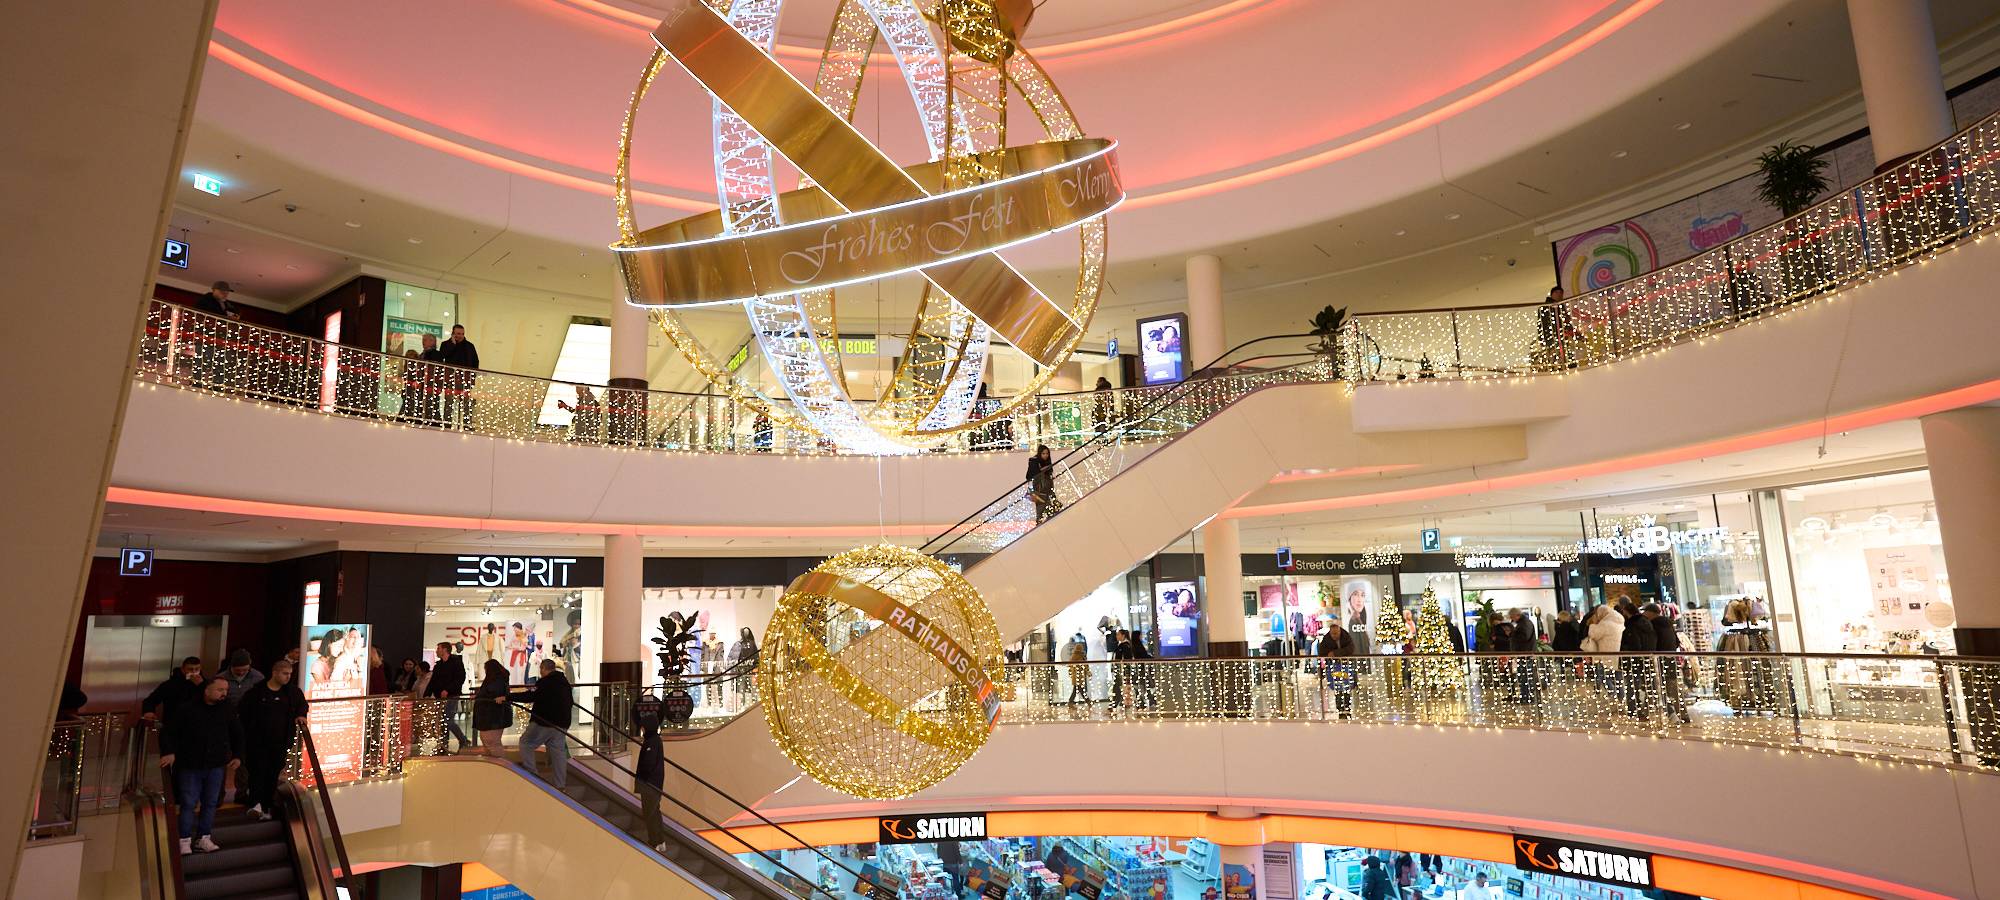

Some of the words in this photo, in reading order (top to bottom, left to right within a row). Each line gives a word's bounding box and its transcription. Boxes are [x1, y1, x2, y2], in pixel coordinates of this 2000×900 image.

[1059, 163, 1110, 208] Merry
[779, 219, 914, 284] Frohes
[926, 193, 1015, 254] Fest
[166, 241, 182, 258] P
[416, 325, 440, 335] NAILS
[846, 340, 877, 354] BODE
[1109, 341, 1116, 354] P
[1425, 531, 1435, 547] P
[128, 551, 145, 569] P
[1296, 560, 1324, 570] Street
[1326, 560, 1345, 570] One
[456, 556, 577, 587] ESPRIT
[916, 817, 985, 840] SATURN
[1558, 847, 1650, 886] SATURN
